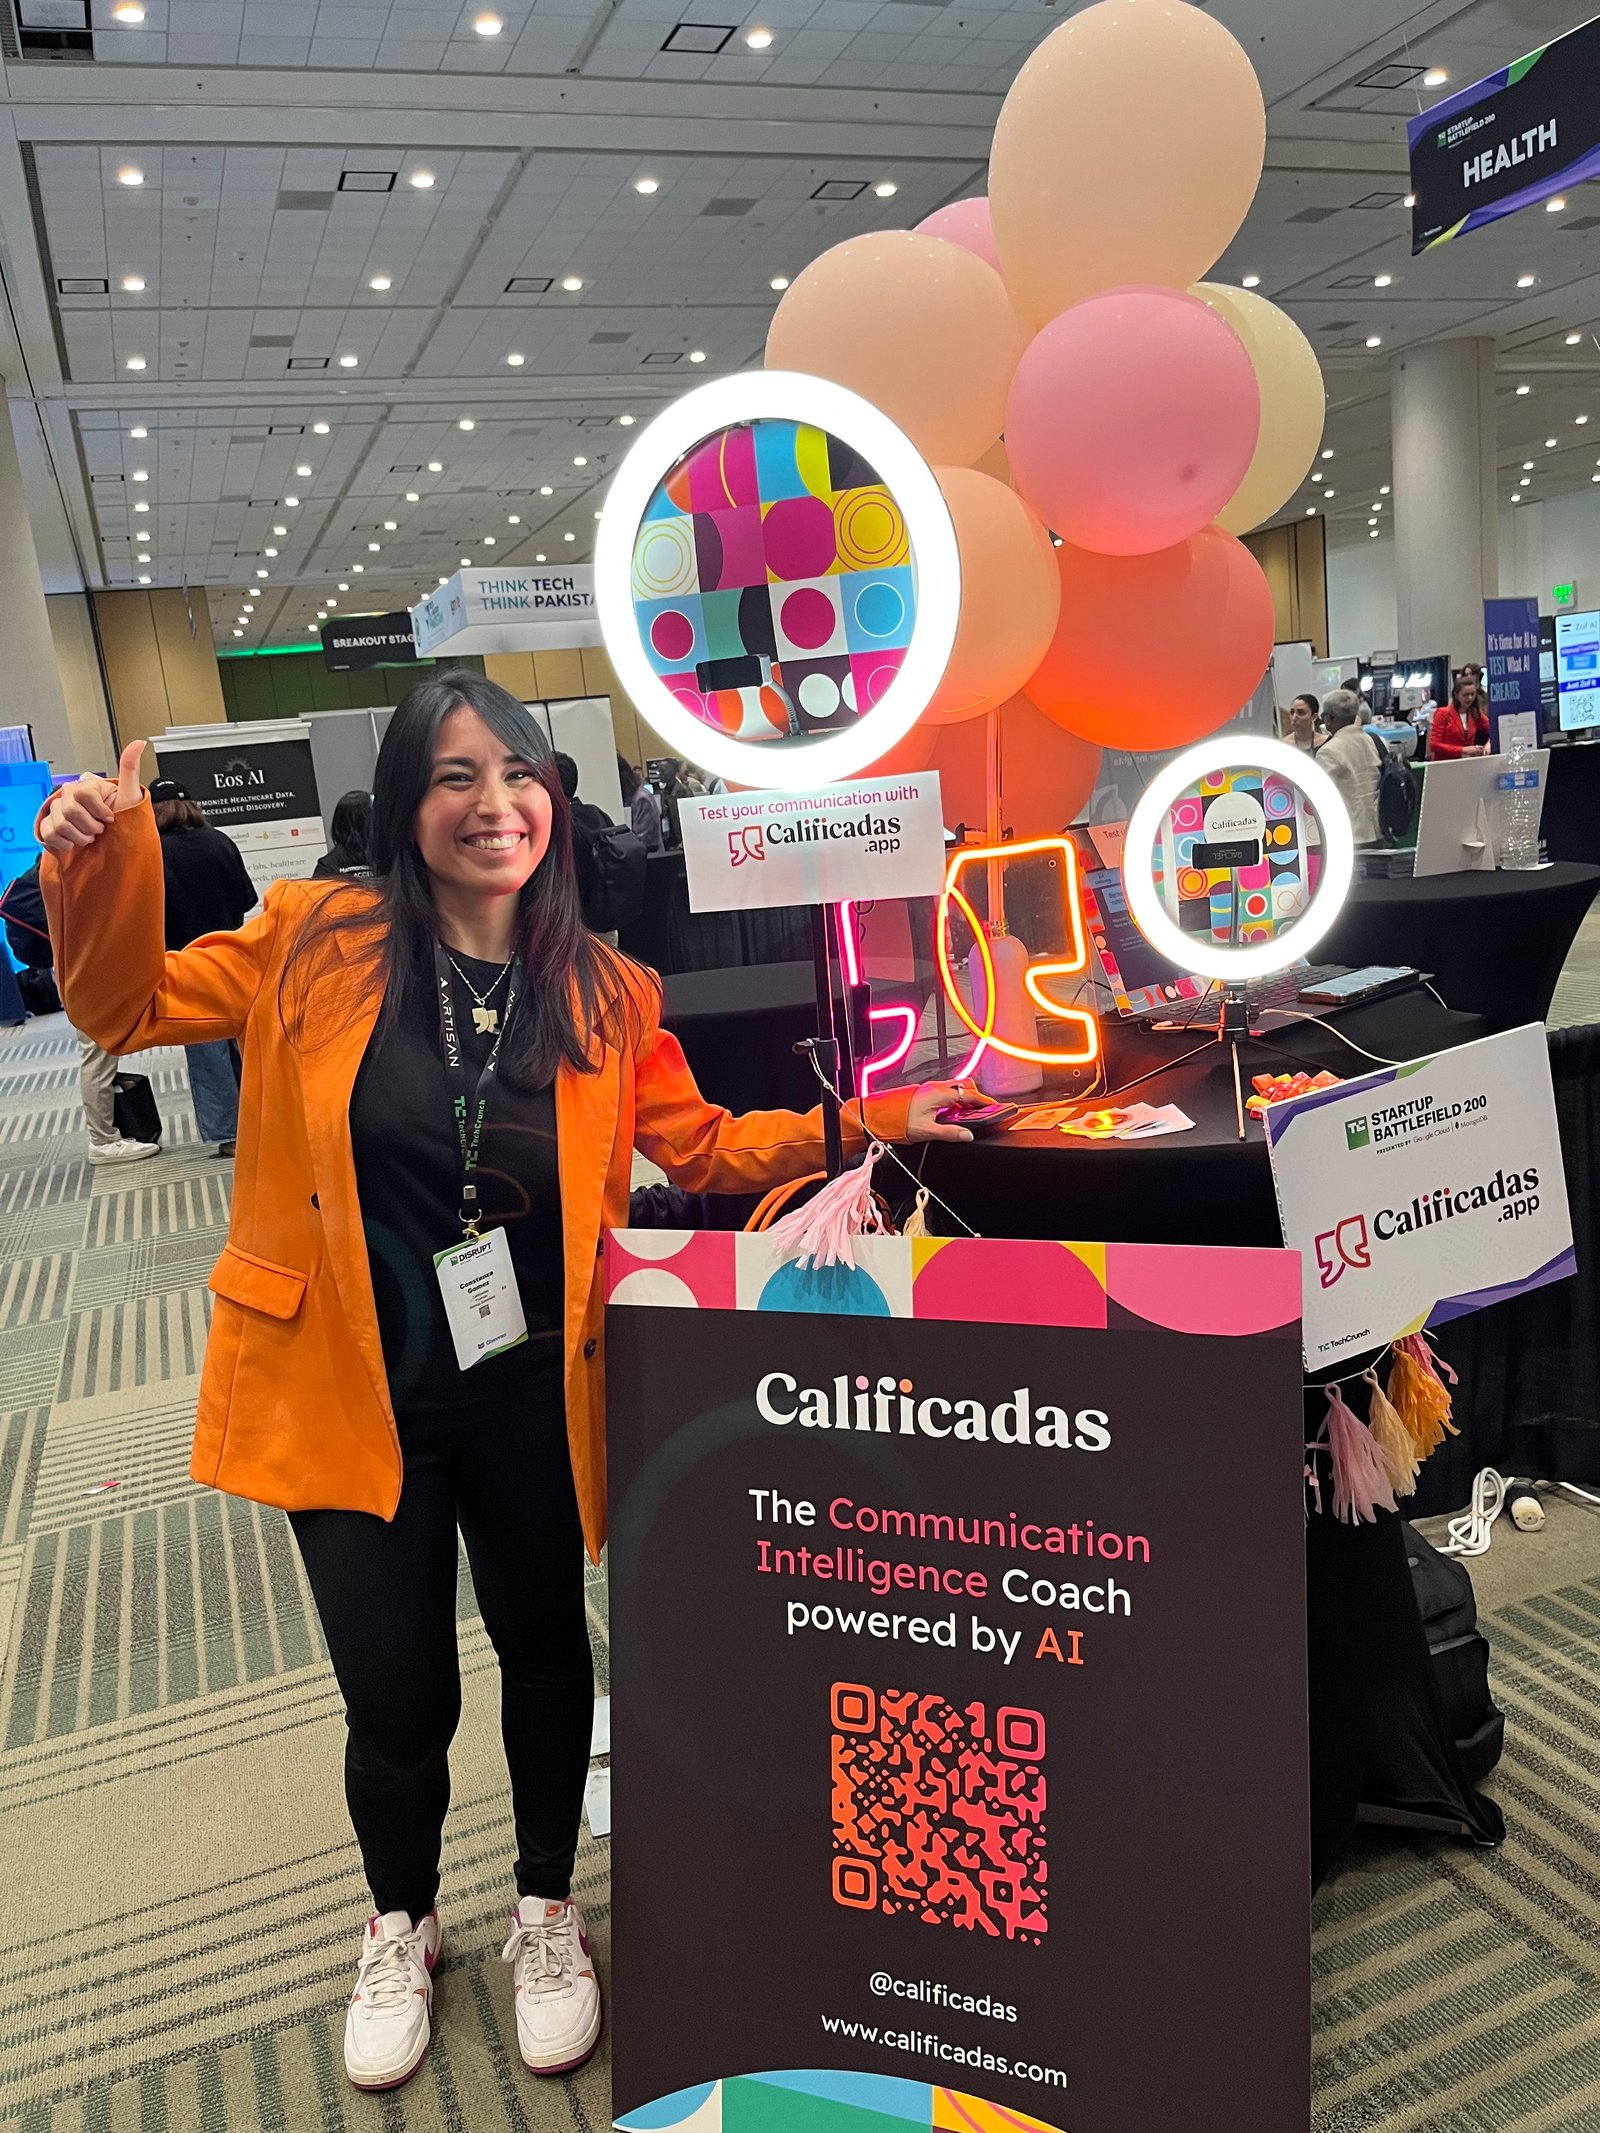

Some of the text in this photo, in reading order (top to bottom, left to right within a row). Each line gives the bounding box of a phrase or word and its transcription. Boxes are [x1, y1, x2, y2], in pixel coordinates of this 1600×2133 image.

[1447, 119, 1485, 143] BATTLEFIELD
[1485, 113, 1496, 125] 200
[1463, 118, 1557, 188] HEALTH
[478, 577, 574, 594] THINK TECH
[480, 595, 531, 610] THINK
[333, 636, 387, 648] BREAKOUT
[1488, 633, 1499, 651] It's
[1499, 633, 1513, 650] time
[1513, 632, 1523, 649] for
[1523, 631, 1530, 648] AI
[1530, 632, 1537, 648] to
[1488, 655, 1531, 676] TEST What AI
[213, 769, 265, 788] Eos AI
[202, 802, 287, 816] ACCELERATE DISCOVERY.
[230, 793, 274, 804] HEALTHCARE
[275, 791, 296, 799] DATA.
[698, 785, 919, 821] Test your communication with
[766, 813, 902, 845] Calificadas
[1211, 817, 1257, 830] Calificadas
[864, 837, 901, 855] .app
[441, 992, 460, 1067] ARTISAN
[470, 1099, 486, 1148] TechCrunch
[1371, 1095, 1433, 1126] STARTUP
[1373, 1094, 1487, 1142] BATTLEFIELD 200
[1376, 1115, 1488, 1155] PRESENTED BY Google Cloud MongoDB
[1373, 1167, 1540, 1241] Calificadas
[1497, 1194, 1540, 1223] .app
[458, 1242, 492, 1262] DISRUPT
[459, 1270, 494, 1290] Constanza
[467, 1280, 490, 1294] Gomez
[1330, 1328, 1370, 1348] TechCrunch
[755, 1372, 1112, 1452] Calificadas
[748, 1488, 1151, 1563] The Communication
[756, 1540, 1132, 1616] Intelligence Coach
[787, 1600, 1085, 1665] powered by AI
[869, 1971, 1018, 2023] @calificadas
[821, 2014, 1067, 2089] www.calificadas.com
